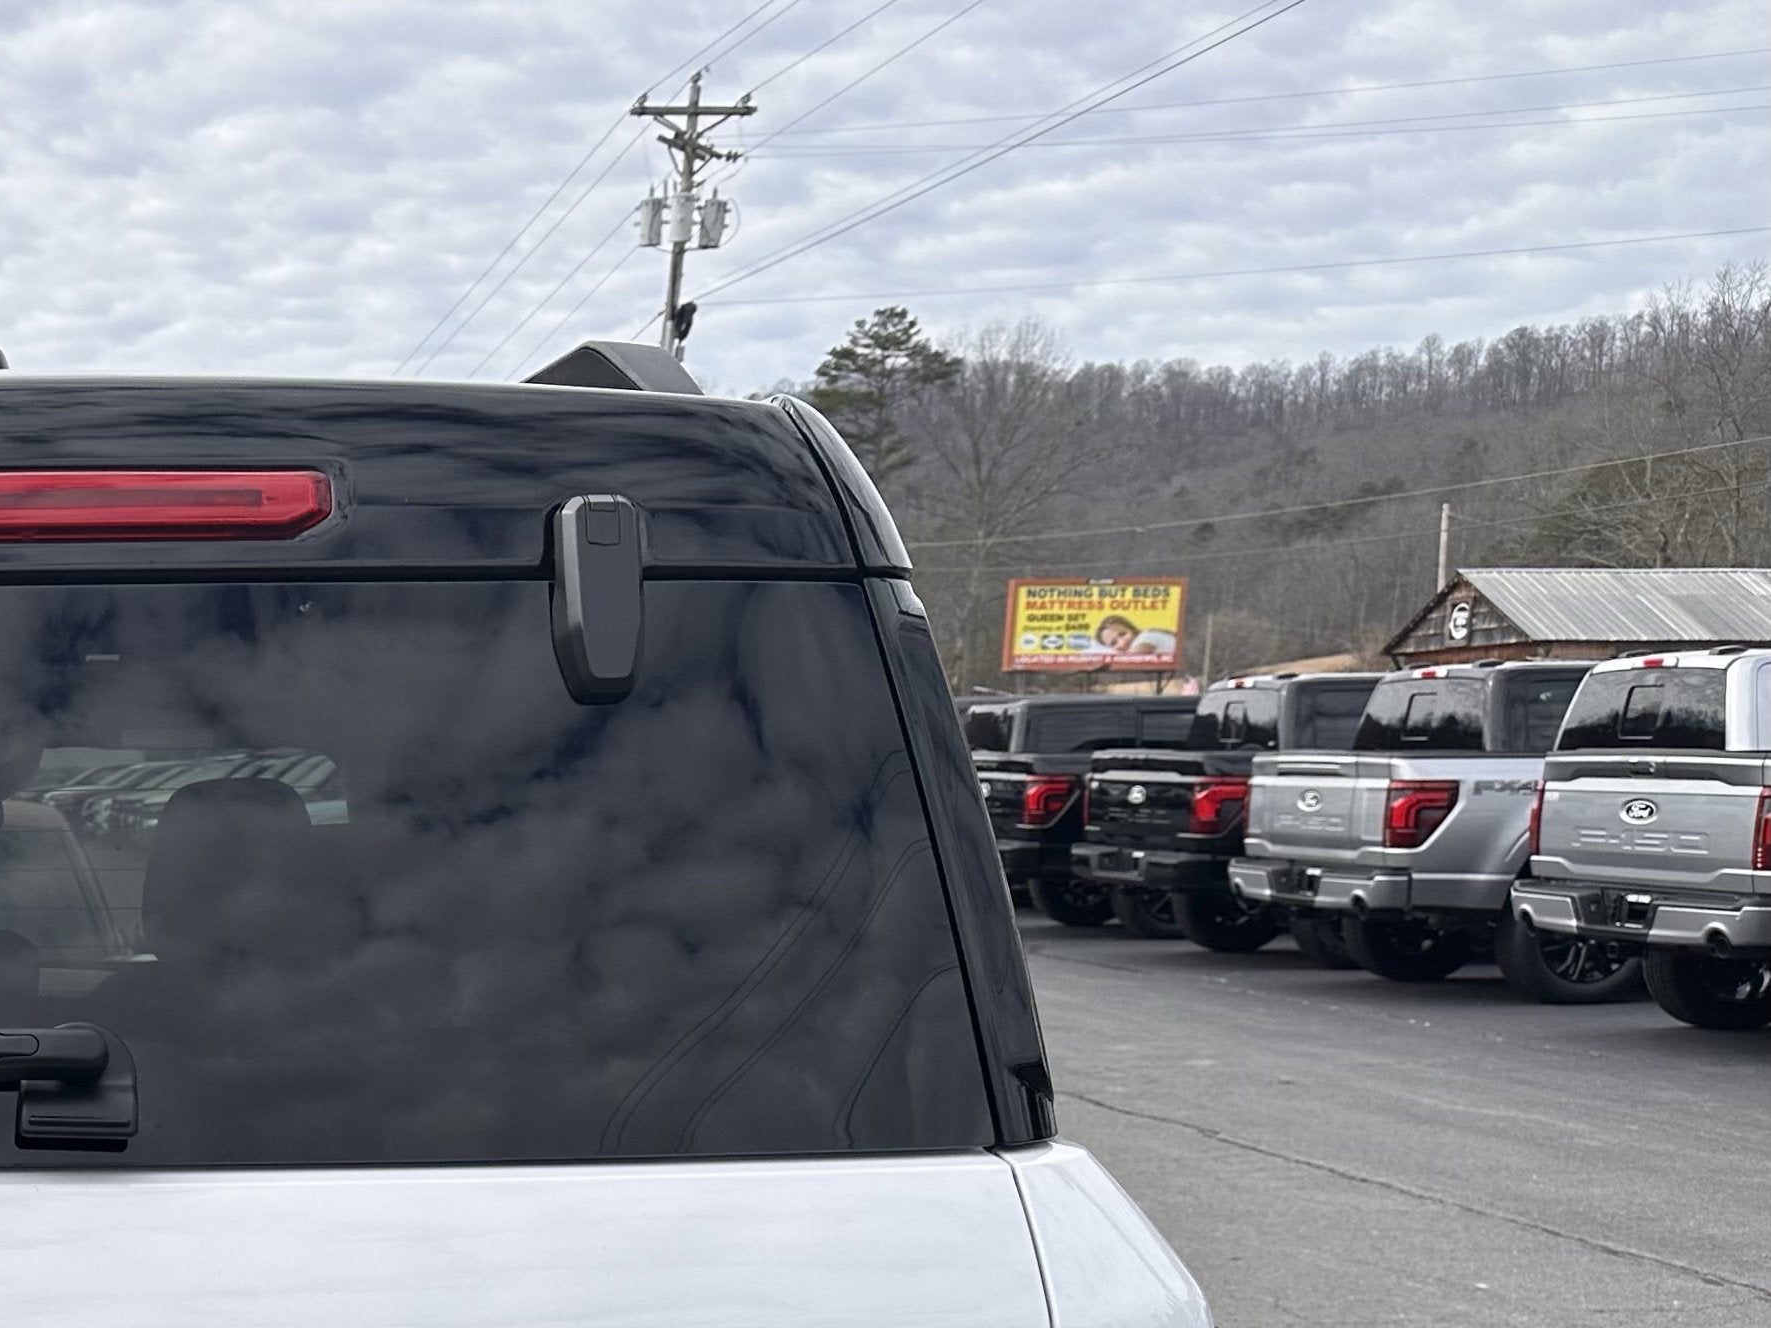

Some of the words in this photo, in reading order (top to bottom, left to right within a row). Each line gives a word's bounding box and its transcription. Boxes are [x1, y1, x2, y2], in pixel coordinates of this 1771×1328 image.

[1026, 587, 1093, 598] NOTHING
[1099, 587, 1127, 598] BUT
[1132, 586, 1170, 598] BEDS
[1025, 599, 1104, 611] MATTRESS
[1110, 599, 1167, 610] OUTLET
[1026, 613, 1064, 622] QUEEN
[1571, 826, 1709, 854] F-150
